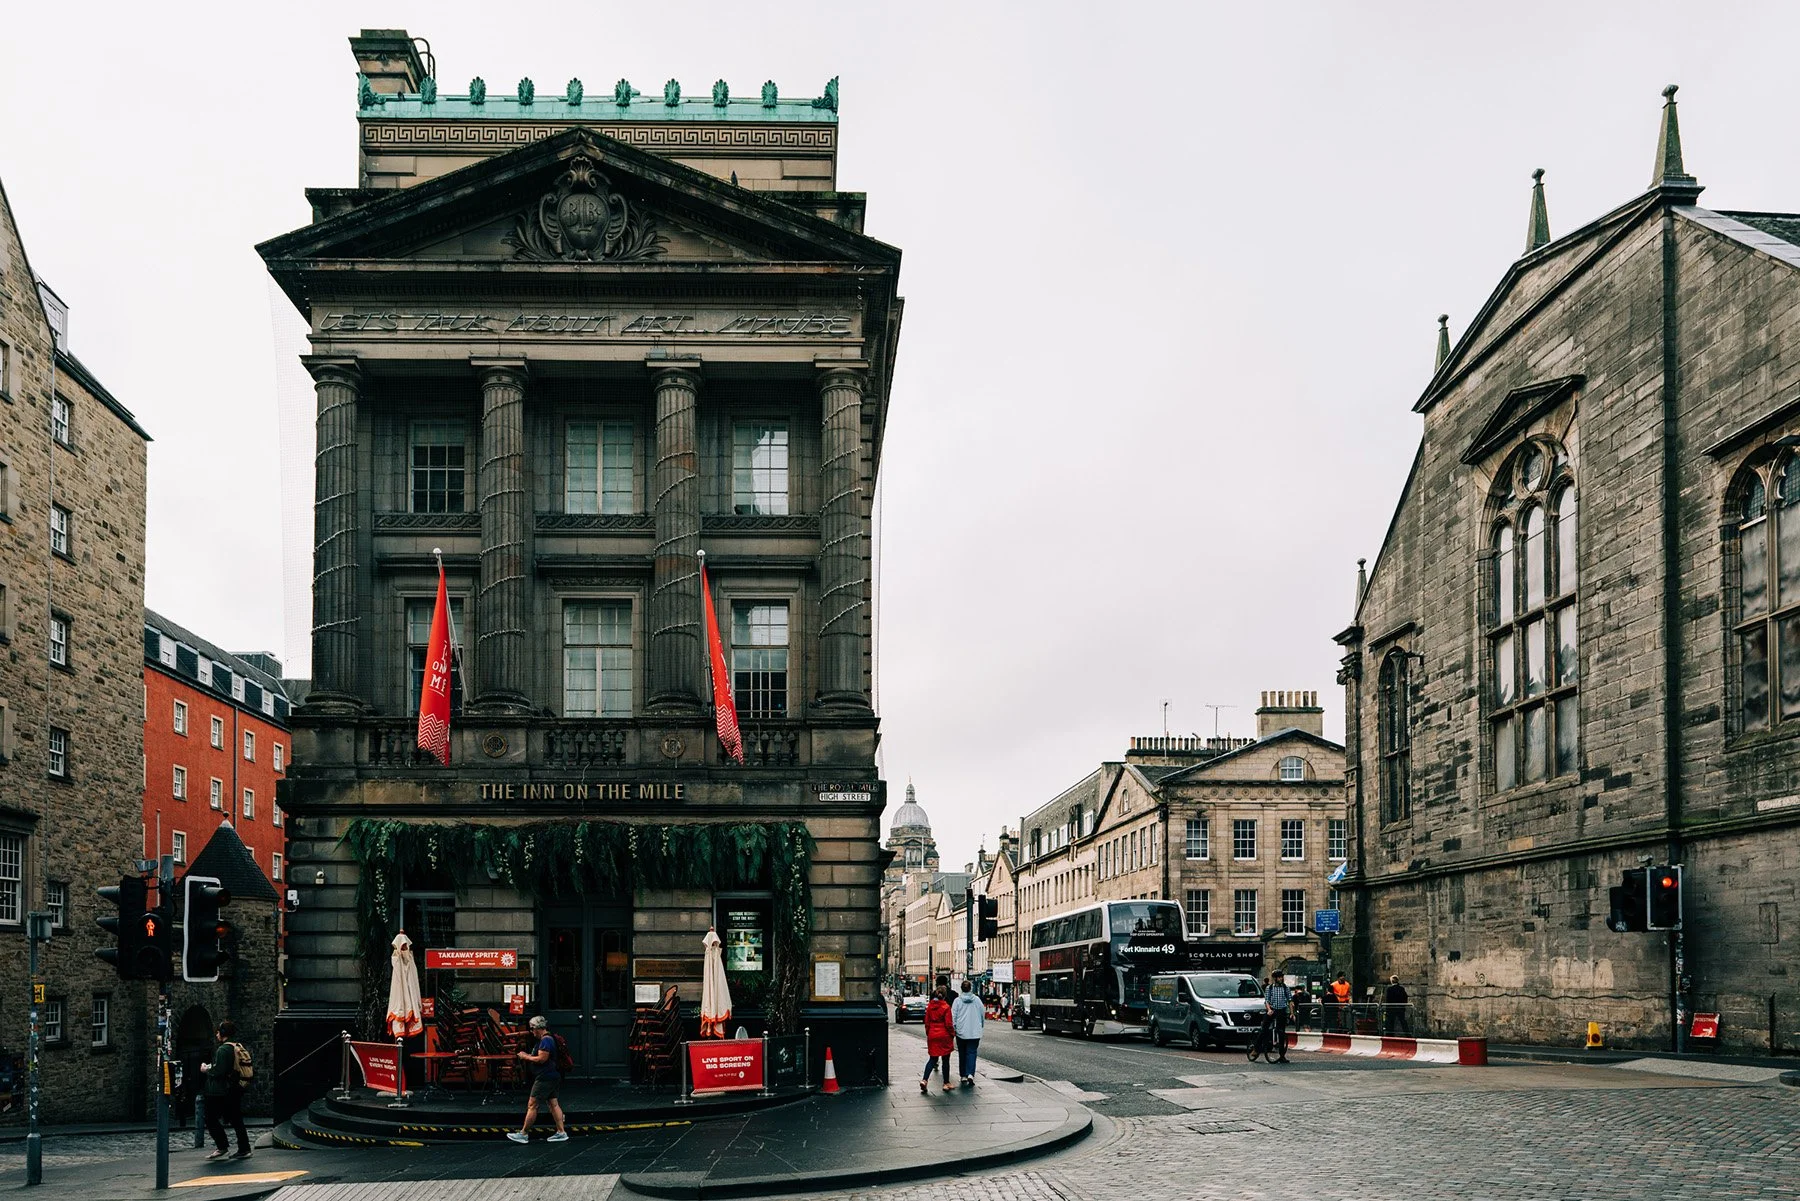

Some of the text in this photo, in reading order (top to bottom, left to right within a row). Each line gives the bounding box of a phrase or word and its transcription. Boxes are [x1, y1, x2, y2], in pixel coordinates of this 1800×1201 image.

[319, 311, 402, 332] LET'S
[413, 312, 498, 333] TALK
[501, 313, 617, 333] ABOUT
[715, 313, 853, 336] MAYBE
[480, 783, 685, 800] THE INN ON THE MILE
[812, 783, 878, 792] THE ROYAL MILE
[820, 793, 869, 801] HIGH STREET
[1120, 944, 1175, 954] Fort Kinnaird 49
